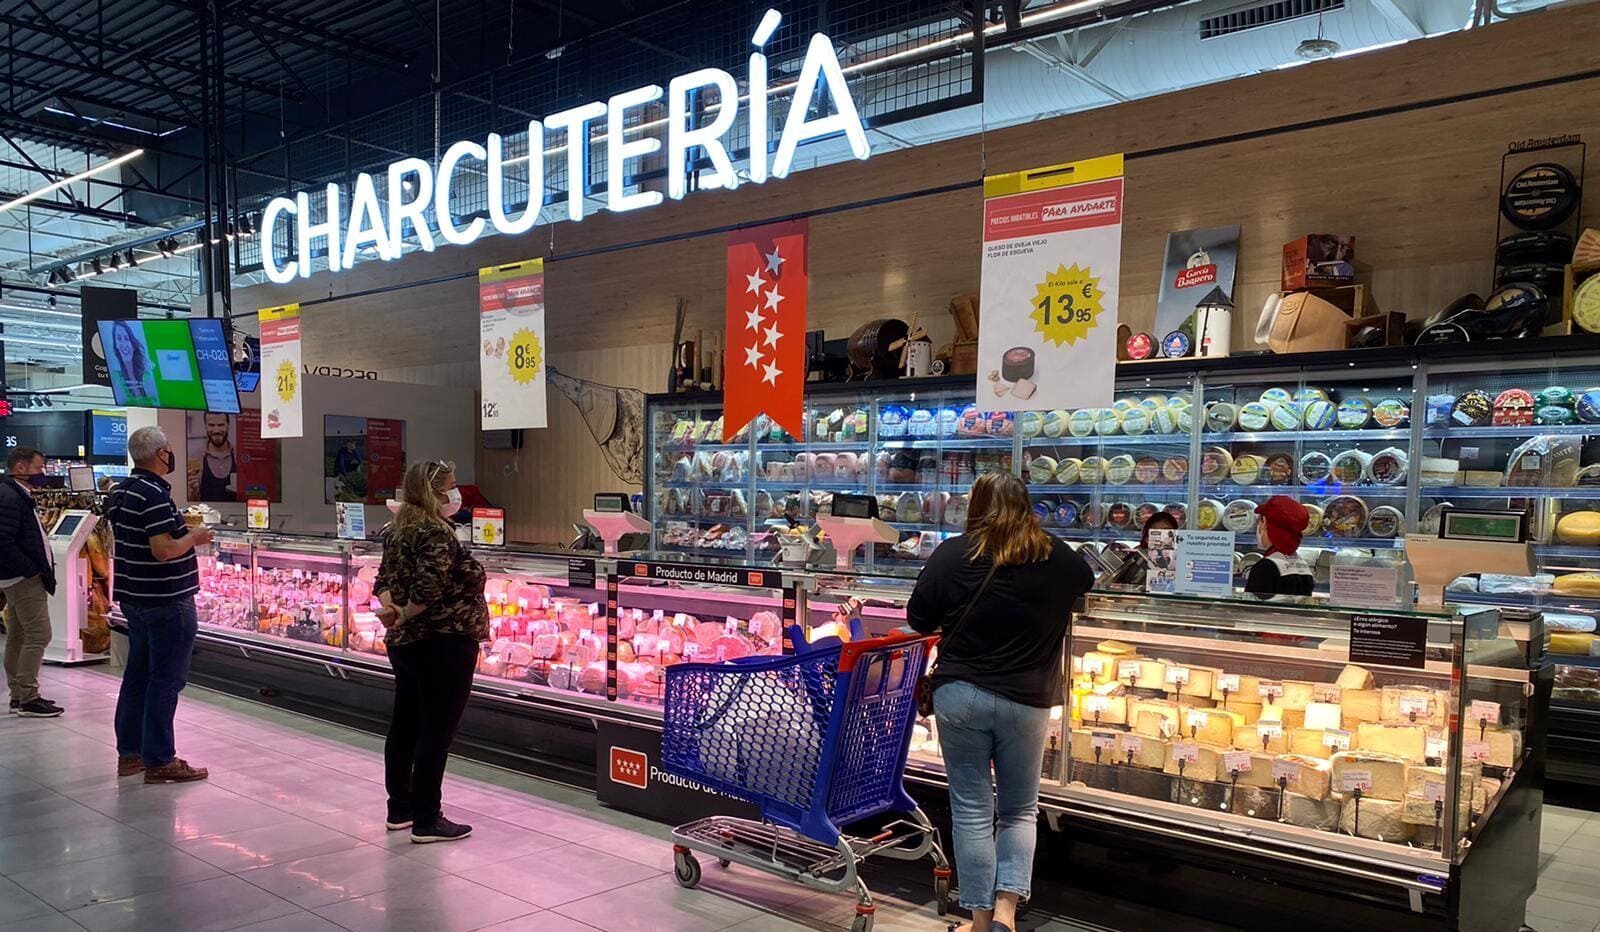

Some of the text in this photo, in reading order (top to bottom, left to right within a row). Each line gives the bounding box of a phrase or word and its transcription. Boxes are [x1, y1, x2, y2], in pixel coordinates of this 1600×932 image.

[261, 8, 871, 284] CHARCUTERÍA
[1508, 134, 1581, 152] Old Amsterdam
[1042, 206, 1067, 217] PARA
[1070, 200, 1116, 214] AYUDARTE
[1014, 241, 1032, 249] OVEJA
[1039, 294, 1074, 325] 13
[1076, 308, 1091, 322] 95
[515, 345, 524, 369] 8
[525, 357, 536, 368] 95
[111, 422, 126, 433] 30
[656, 566, 738, 583] Producto de Madrid
